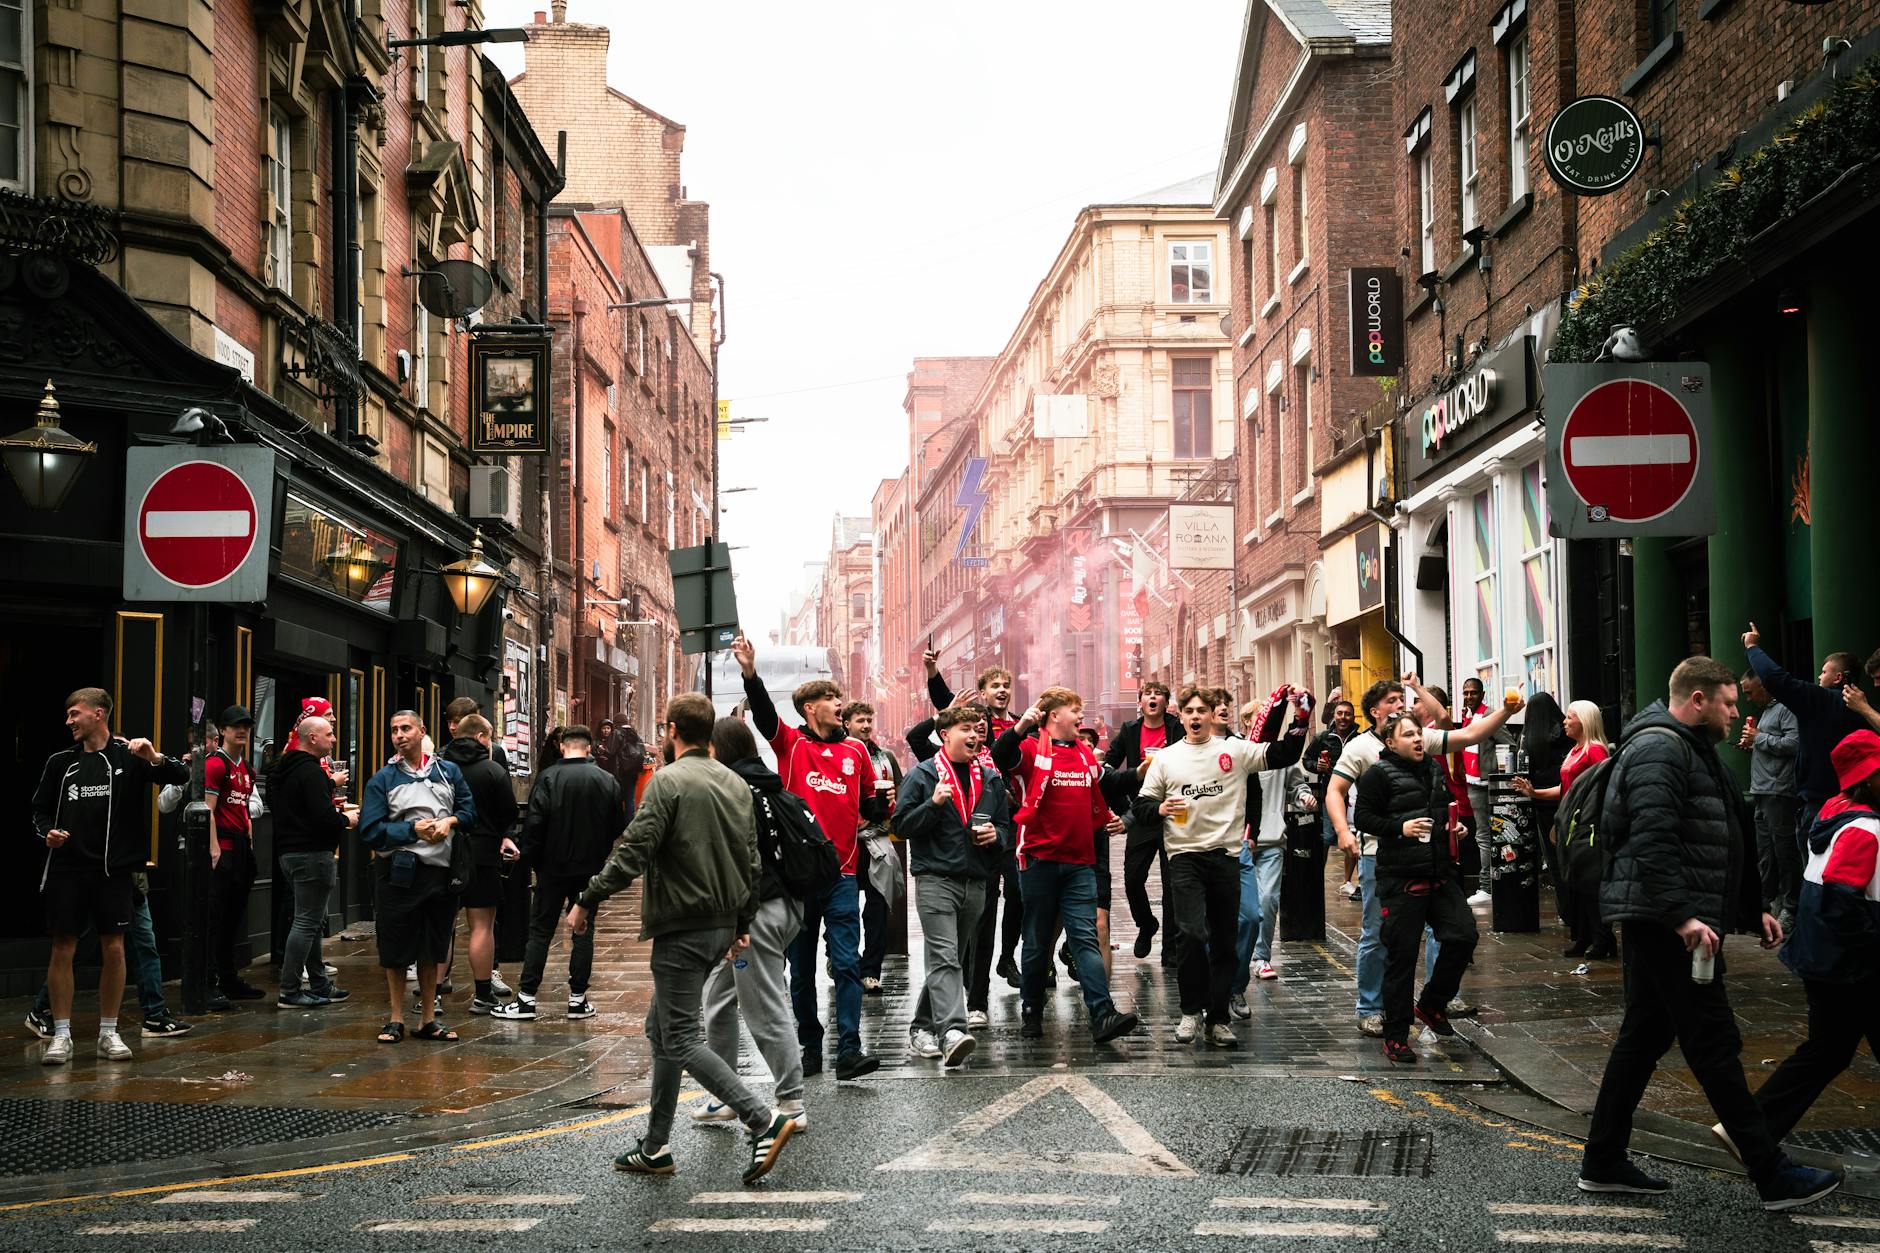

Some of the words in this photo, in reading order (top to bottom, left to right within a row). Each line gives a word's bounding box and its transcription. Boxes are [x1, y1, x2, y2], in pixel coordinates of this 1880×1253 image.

[1555, 120, 1634, 163] O'Neill's
[1564, 165, 1580, 178] EAT
[1587, 172, 1617, 182] DRINK
[1621, 141, 1636, 170] ENJOY
[231, 349, 249, 375] STREET
[480, 411, 496, 425] THE
[486, 422, 535, 440] EMPIRE
[1184, 521, 1219, 532] VILLA
[1054, 770, 1085, 779] Standard
[80, 784, 110, 792] standar
[806, 771, 848, 795] Carlsberg
[1051, 779, 1085, 787] Chartered
[1181, 780, 1224, 799] Carlsberg
[80, 790, 110, 798] chartere
